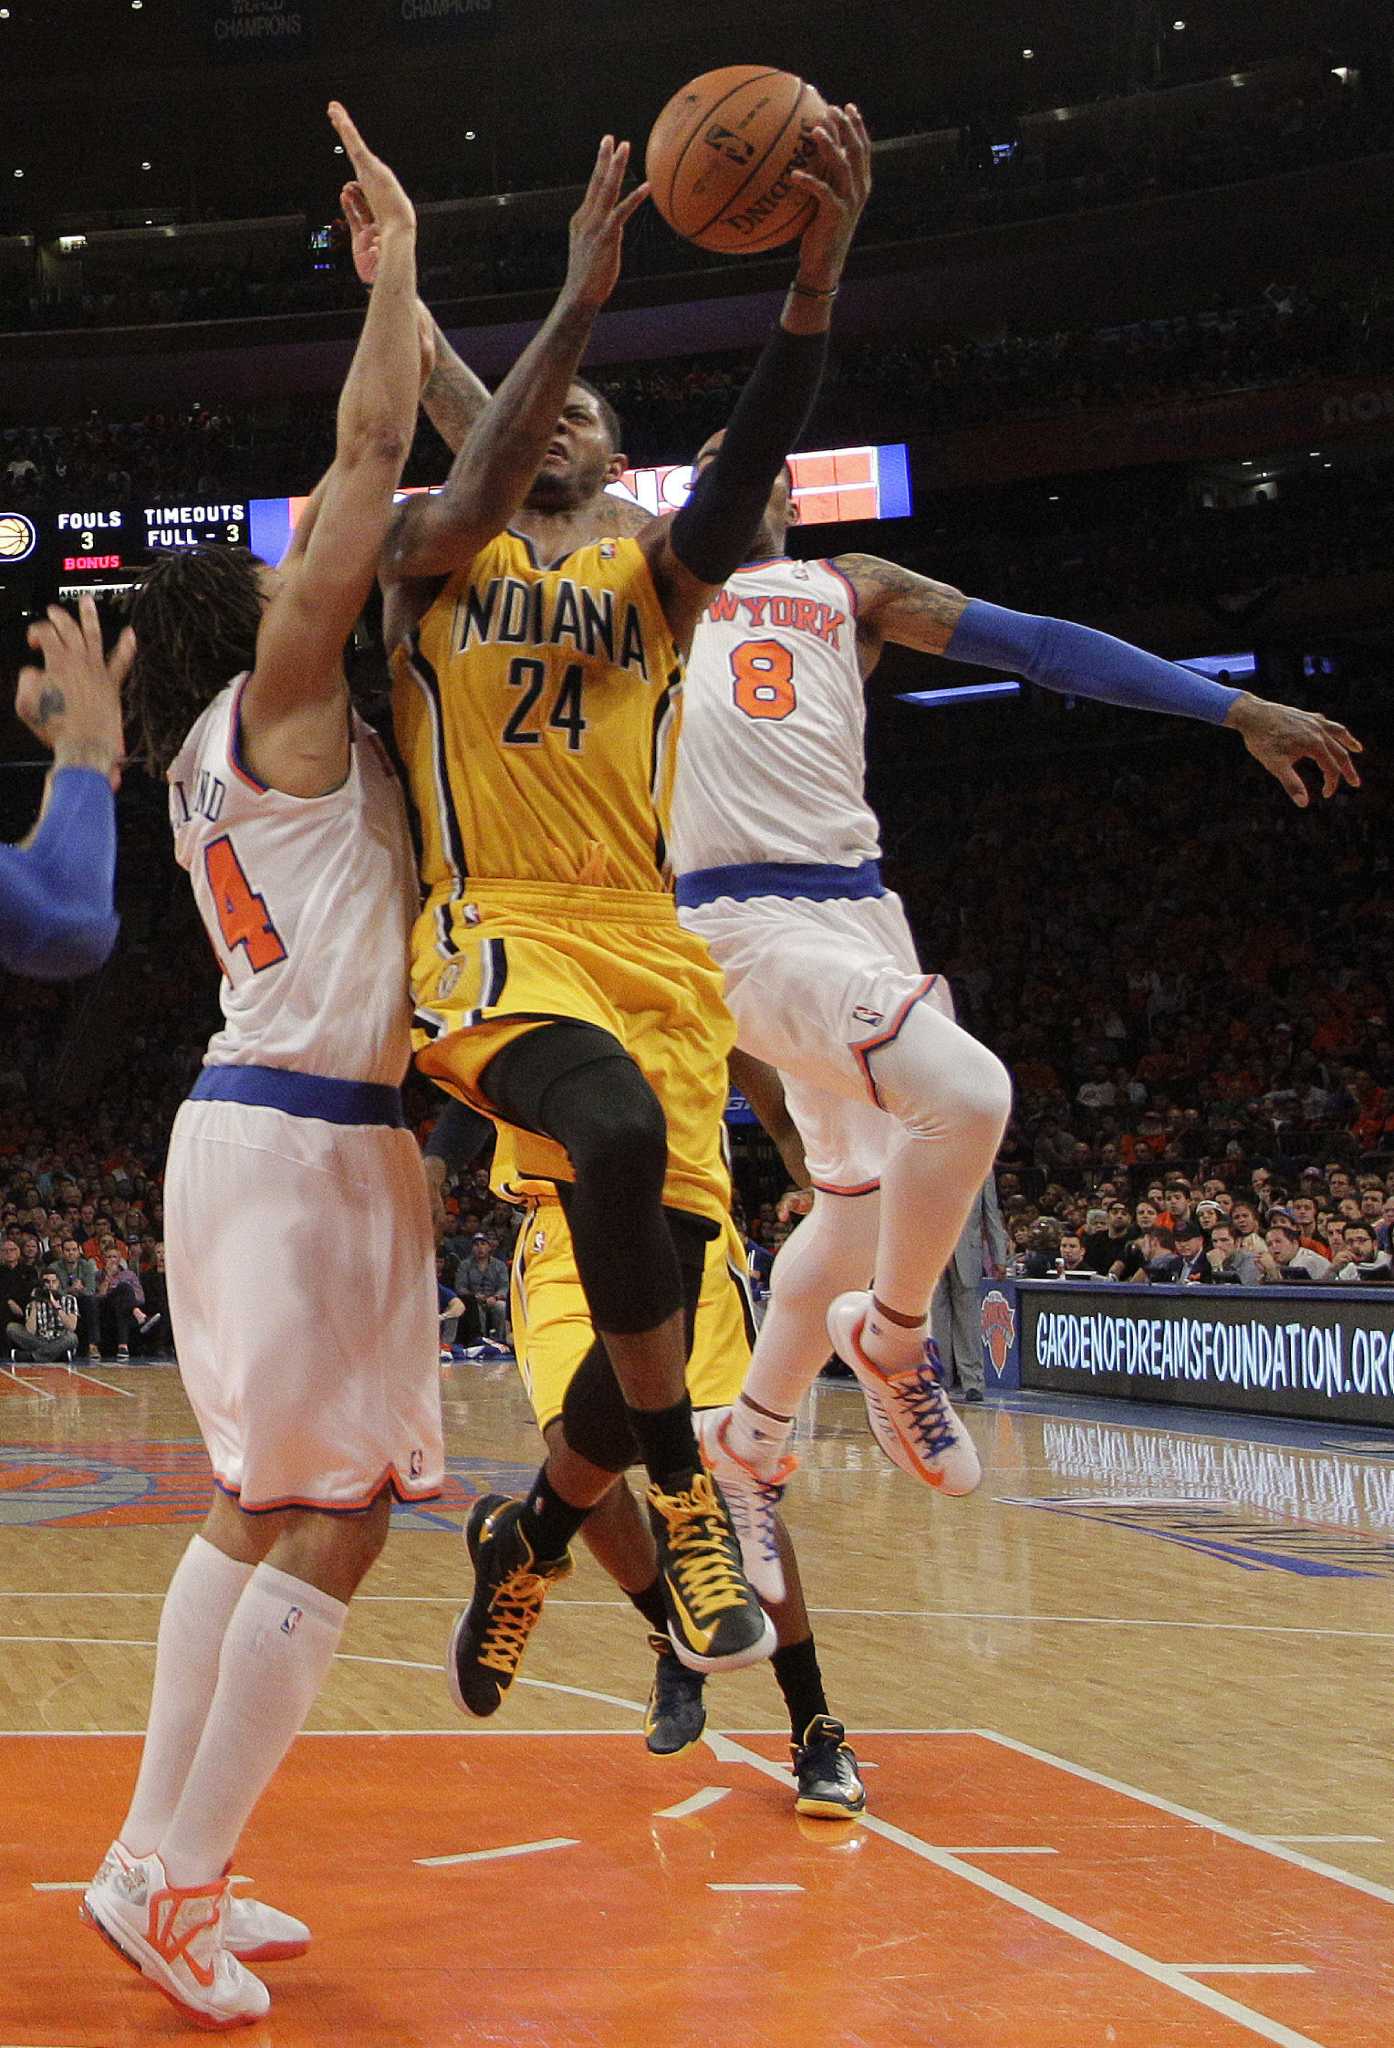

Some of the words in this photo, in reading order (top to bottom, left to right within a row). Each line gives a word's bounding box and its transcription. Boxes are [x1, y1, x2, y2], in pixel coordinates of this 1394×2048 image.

[214, 14, 303, 40] CHAMPIONS
[58, 511, 121, 529] FOULS
[144, 505, 244, 525] TIMEOUTS
[81, 532, 94, 549] 3
[148, 529, 198, 547] FULL
[226, 524, 239, 542] 3
[64, 556, 119, 571] BONUS
[741, 596, 846, 652] YORK
[729, 639, 797, 721] 8
[502, 657, 586, 752] 24
[203, 833, 288, 974] 4
